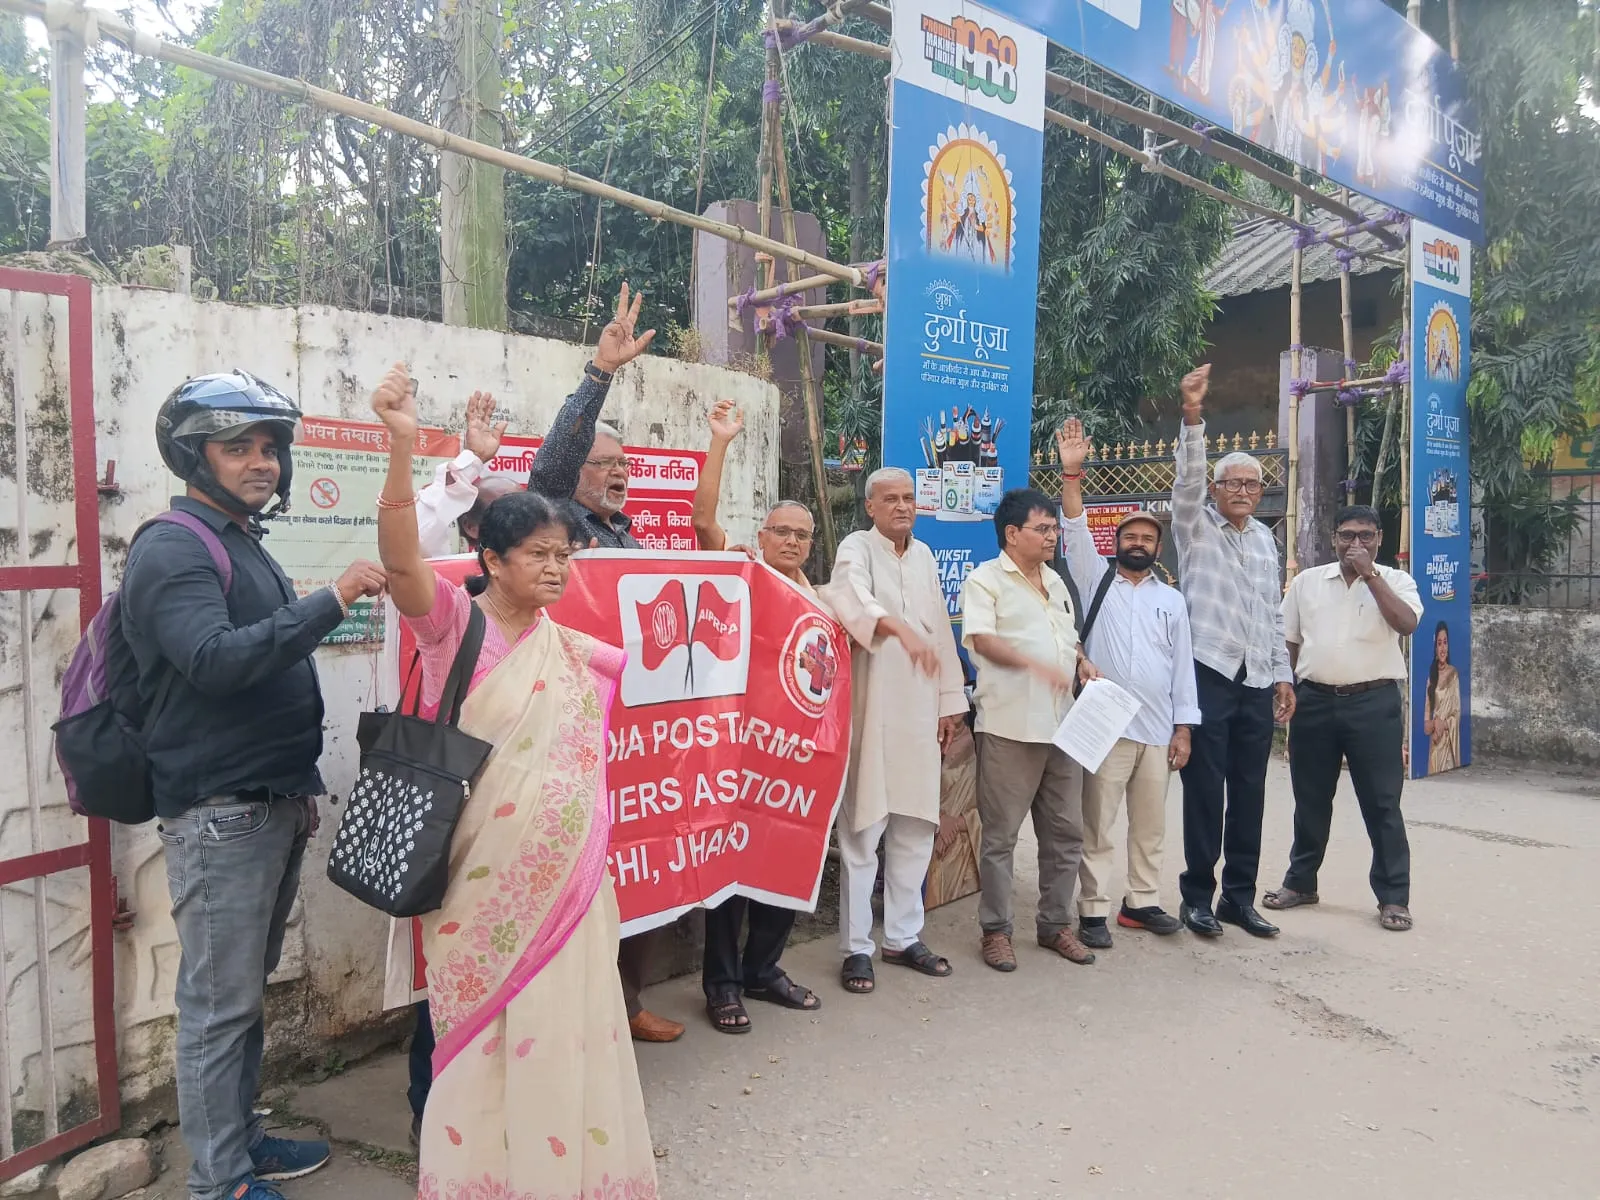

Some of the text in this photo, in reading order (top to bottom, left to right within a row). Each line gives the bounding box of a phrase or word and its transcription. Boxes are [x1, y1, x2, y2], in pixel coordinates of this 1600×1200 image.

[926, 31, 956, 54] MAKING
[926, 44, 955, 67] IN INDIA
[1443, 114, 1477, 174] पूजा
[924, 309, 1010, 359] दुर्गा पूजा
[1426, 409, 1460, 439] दुर्गा पूजा
[340, 427, 387, 450] तम्बाकू
[660, 459, 696, 480] वर्जित
[1147, 500, 1172, 512] KIN
[632, 509, 693, 533] सूचित किया
[935, 549, 972, 561] VIKSIT
[1426, 561, 1460, 575] BHARAT
[698, 608, 739, 635] AIPRPA
[607, 725, 645, 763] DIA
[741, 716, 818, 763] RMS
